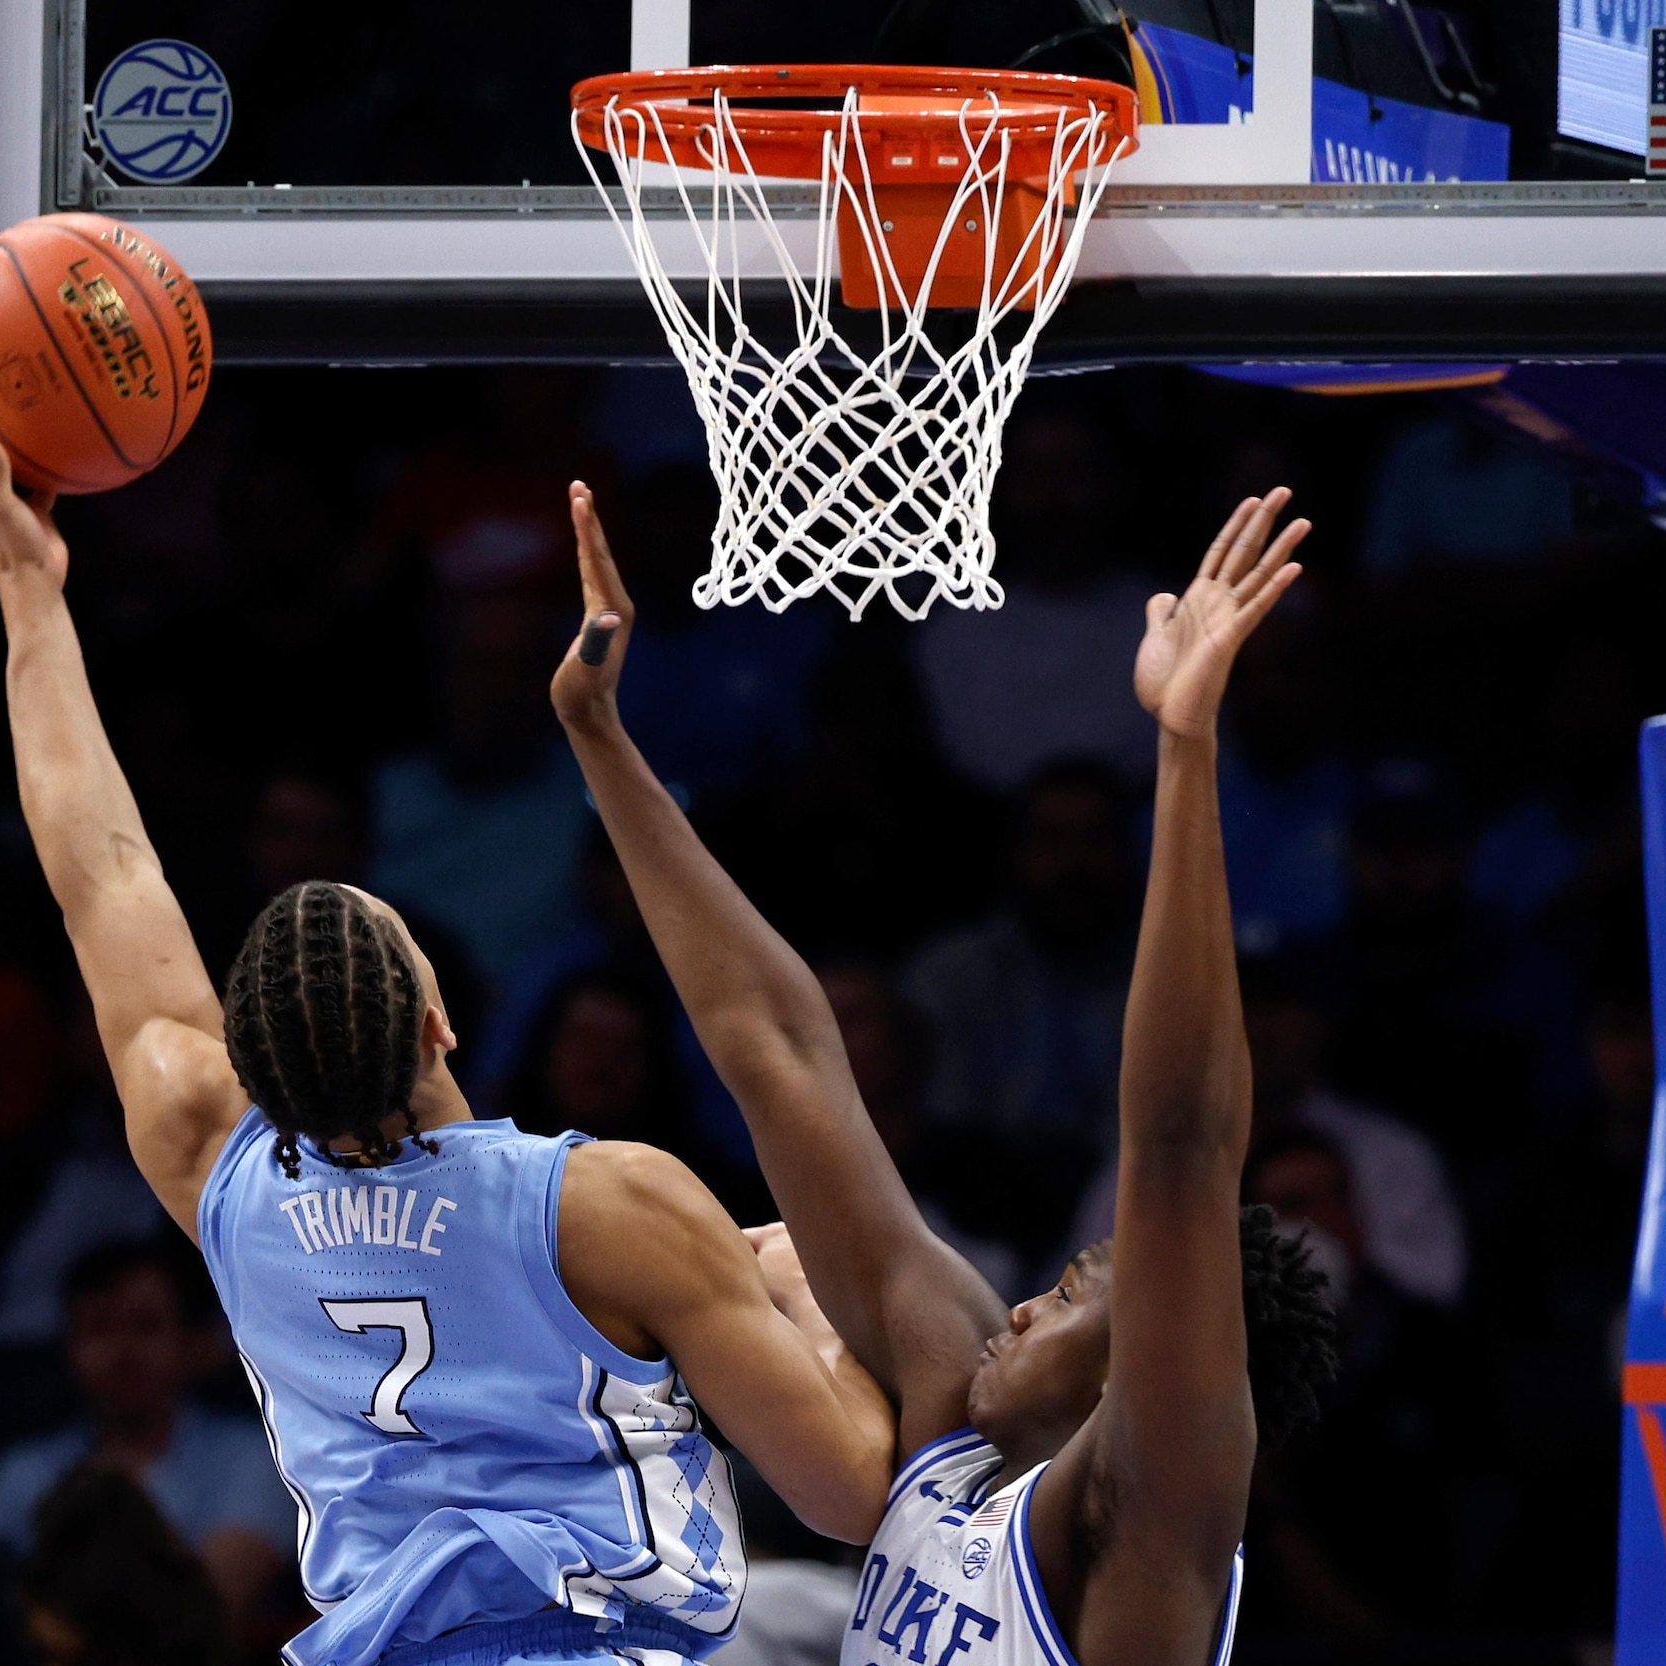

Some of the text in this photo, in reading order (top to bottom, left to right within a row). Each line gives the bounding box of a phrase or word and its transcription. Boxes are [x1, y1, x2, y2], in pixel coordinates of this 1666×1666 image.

[111, 86, 224, 116] ACC
[68, 257, 161, 399] LEGACY
[279, 1185, 458, 1256] TRIMBLE
[318, 1296, 435, 1437] 7
